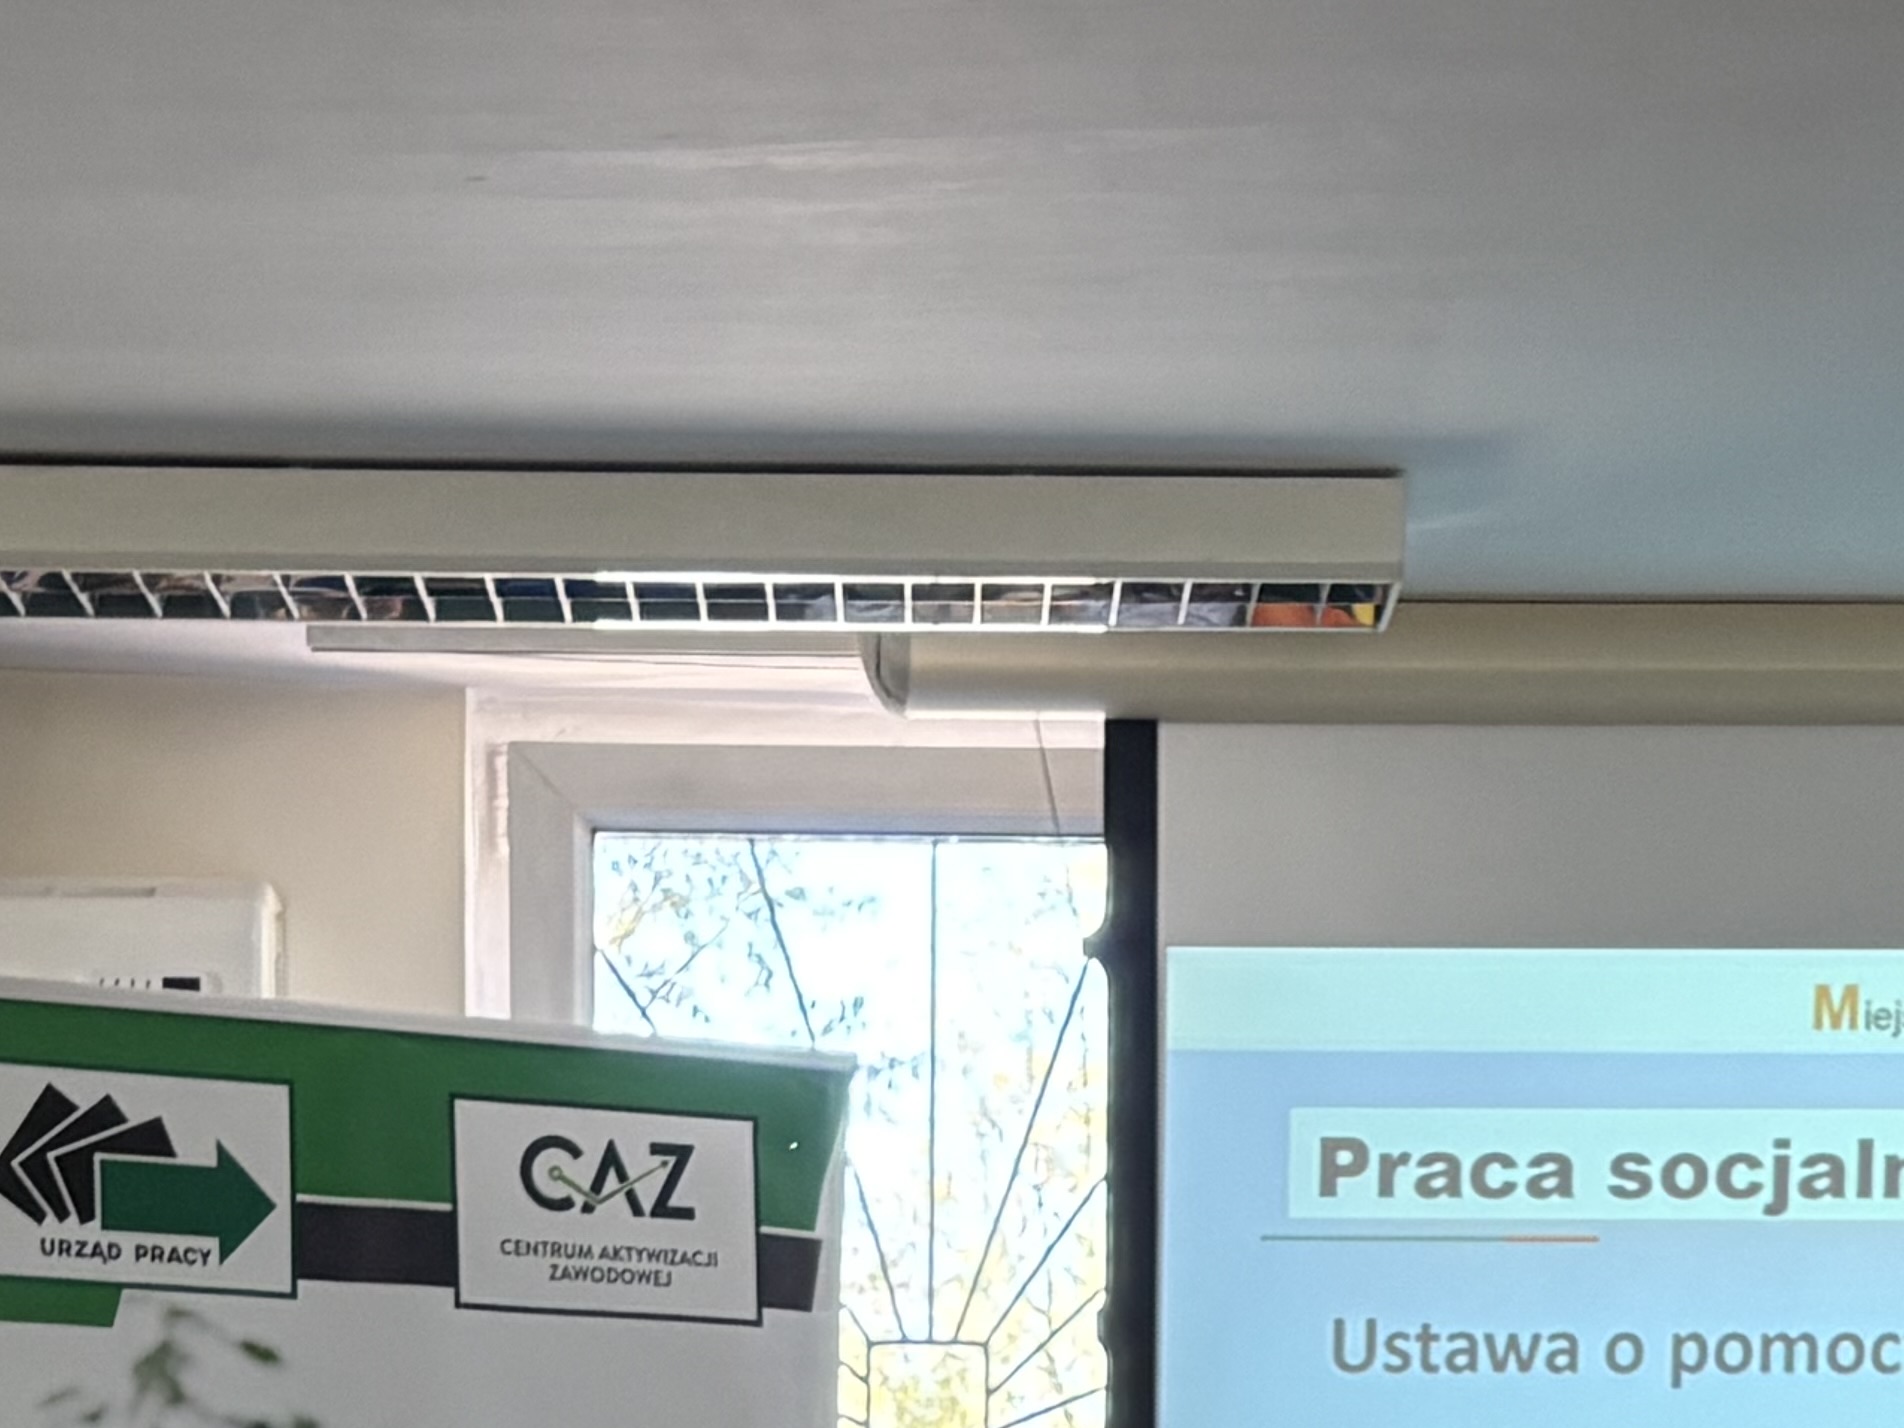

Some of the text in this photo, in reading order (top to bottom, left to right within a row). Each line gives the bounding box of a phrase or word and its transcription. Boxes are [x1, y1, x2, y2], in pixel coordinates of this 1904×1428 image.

[519, 1134, 696, 1221] CAZ
[1318, 1136, 1576, 1201] Praca
[39, 1237, 212, 1267] URZĄD PRACY
[499, 1238, 719, 1268] CENTRUM AKTYWIZACJI
[548, 1263, 673, 1288] ZAWODOWEJ
[1332, 1317, 1580, 1376] Ustawa
[1604, 1331, 1645, 1376] o
